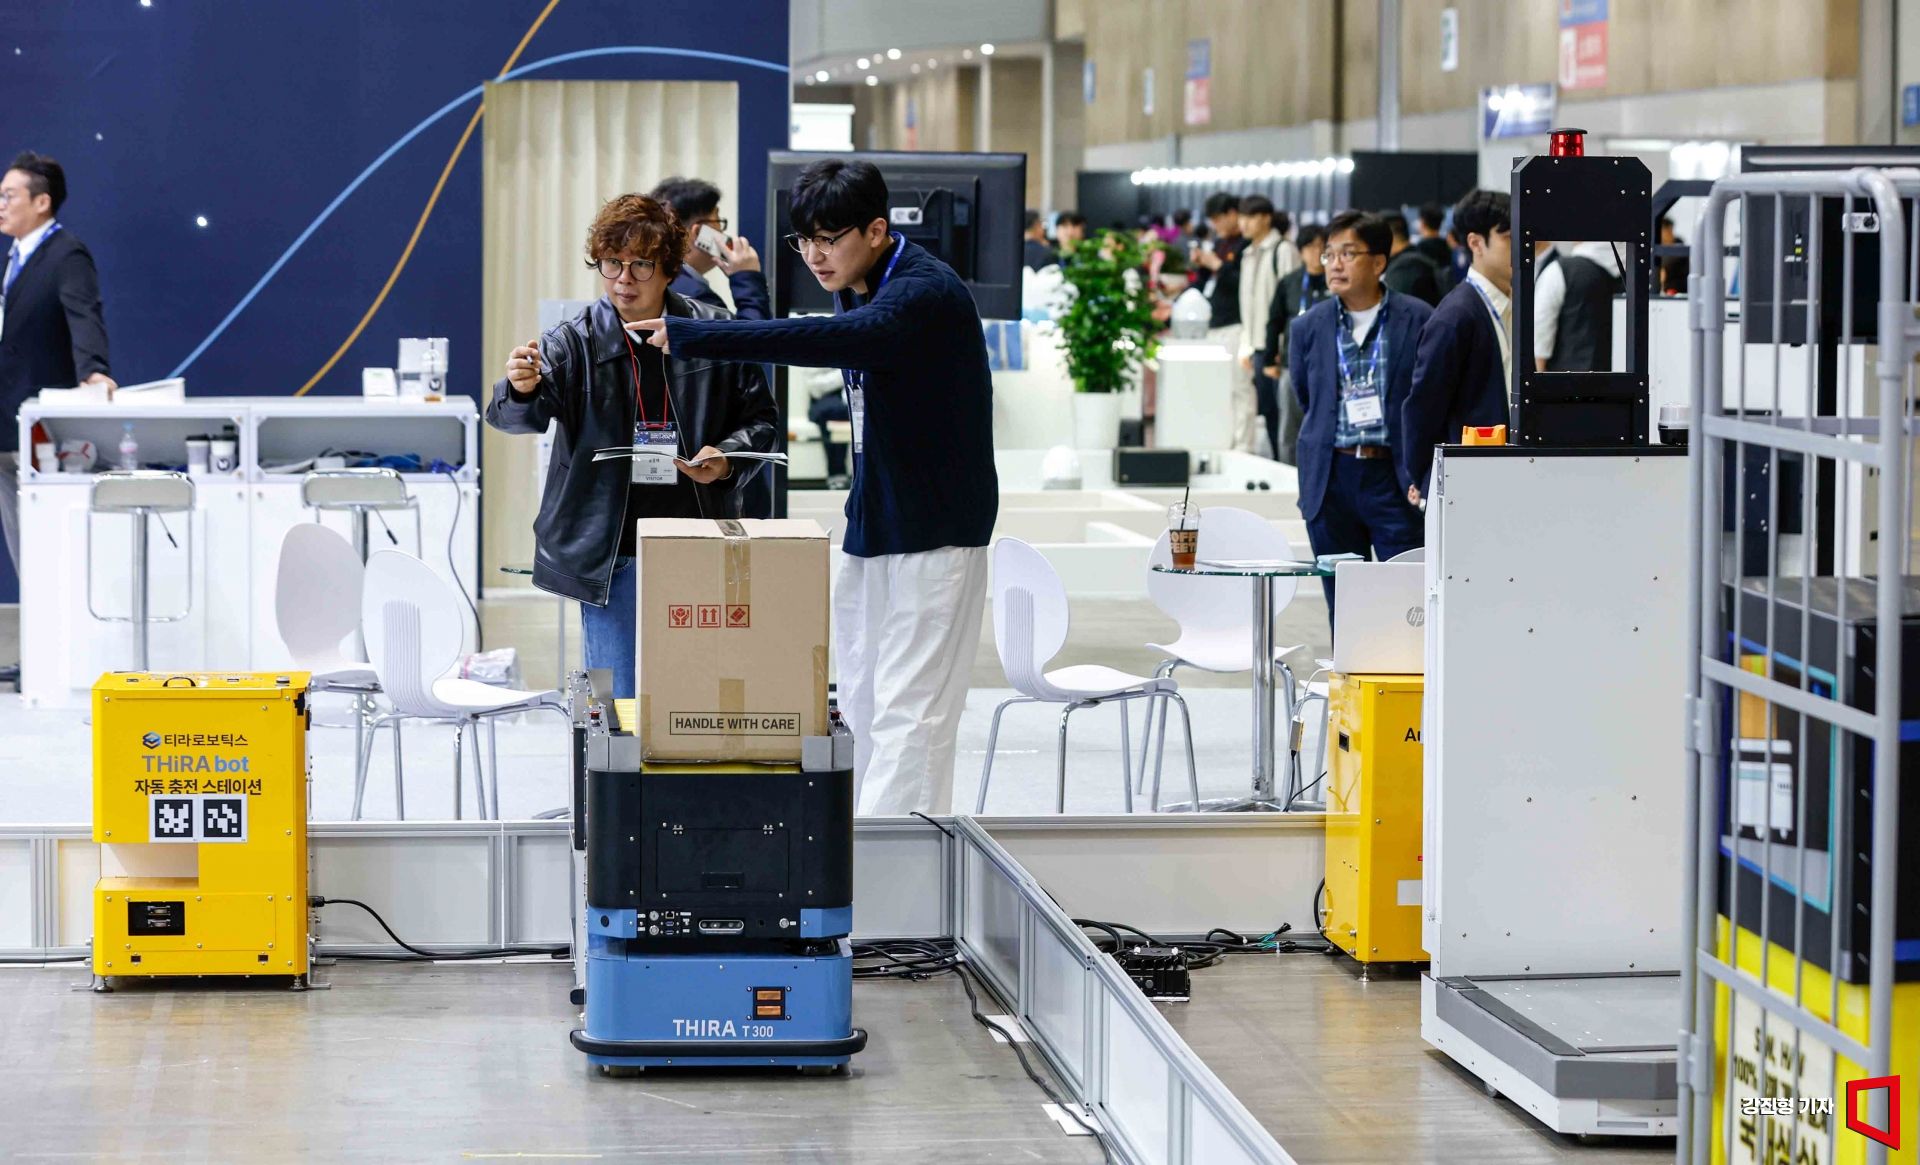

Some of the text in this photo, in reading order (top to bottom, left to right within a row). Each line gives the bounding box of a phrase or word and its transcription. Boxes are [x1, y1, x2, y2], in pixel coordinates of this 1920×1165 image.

[1408, 606, 1424, 627] hp
[675, 717, 795, 730] HANDLE WITH CARE
[164, 733, 248, 747] 티라로보틱스
[134, 778, 262, 796] 자동 충전 스테이션
[672, 1019, 737, 1037] THIRA
